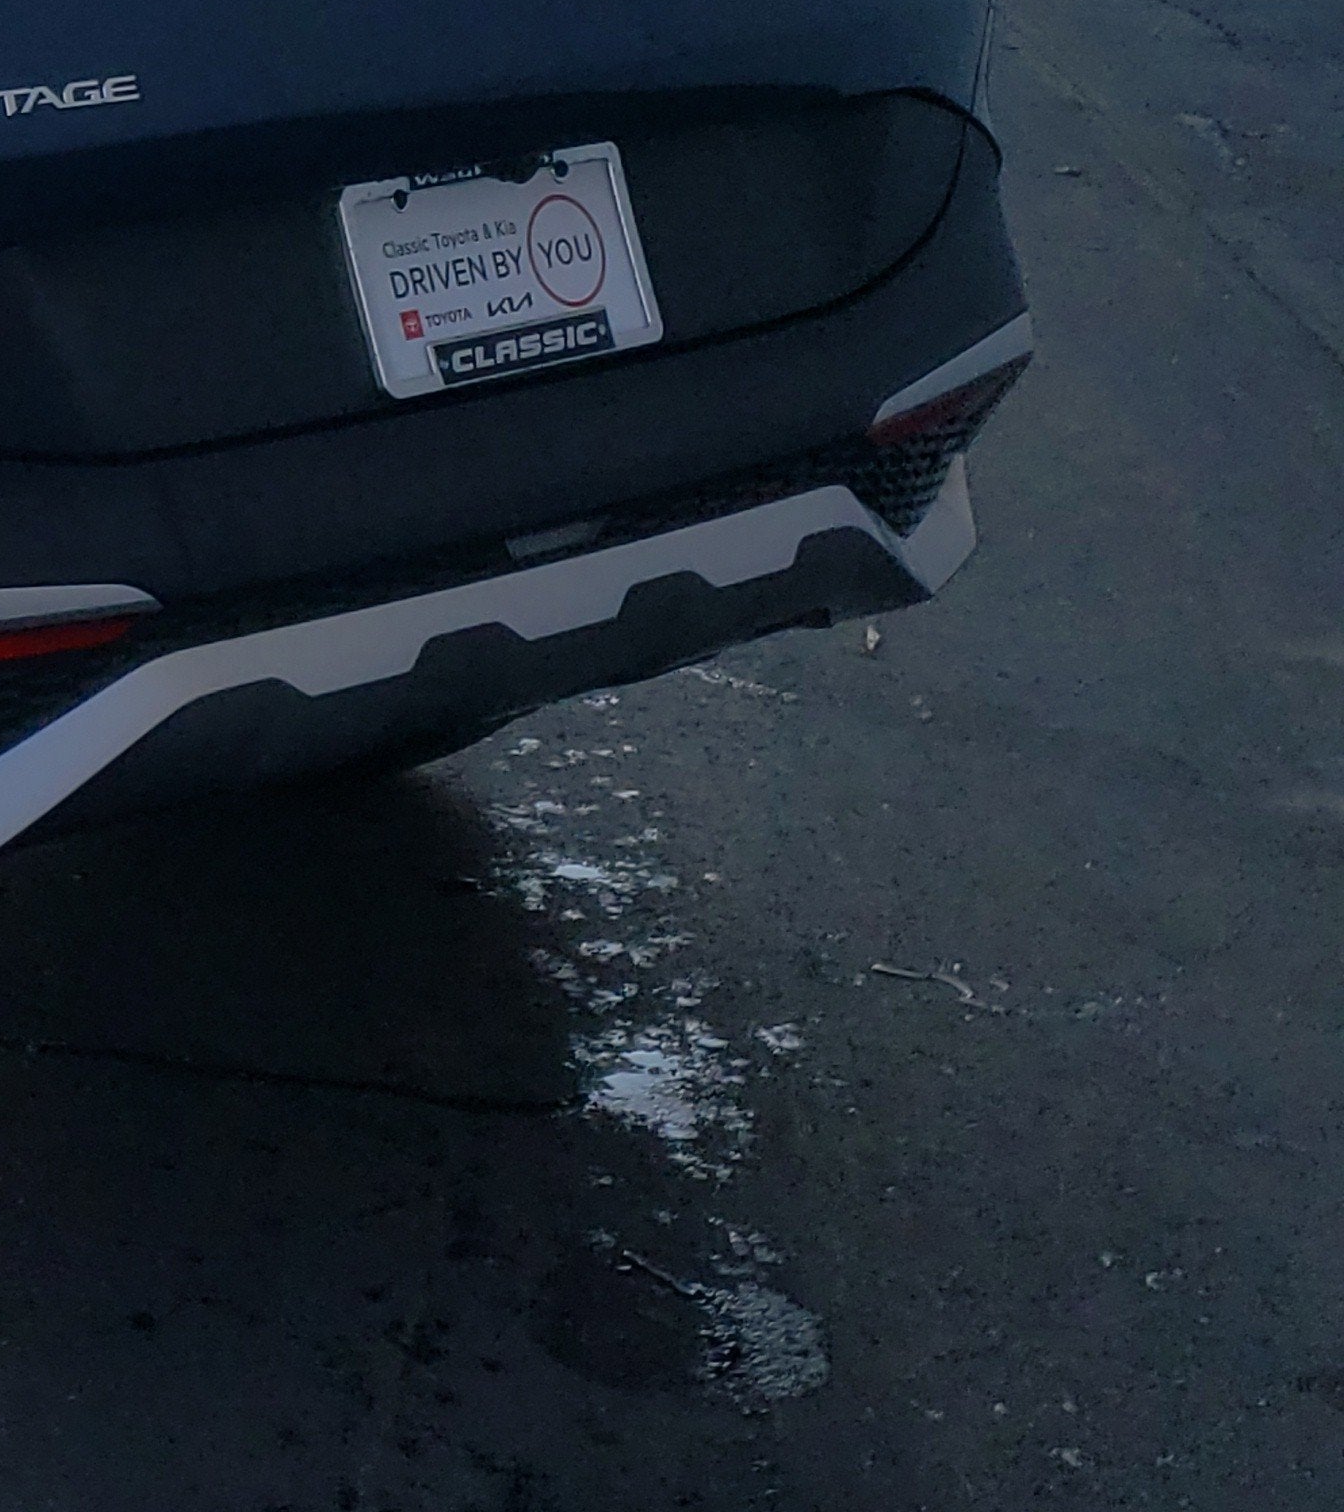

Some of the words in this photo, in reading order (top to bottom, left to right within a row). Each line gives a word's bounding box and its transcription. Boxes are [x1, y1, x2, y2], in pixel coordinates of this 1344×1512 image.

[382, 238, 431, 260] Classic
[431, 228, 480, 252] Toyota
[481, 223, 493, 240] &
[494, 219, 518, 238] Kia
[389, 253, 487, 300] DRIVEN
[492, 246, 523, 279] BY
[537, 233, 593, 269] YOU
[425, 307, 473, 329] TOYOTA
[486, 291, 534, 319] KIA
[451, 321, 600, 374] CLASSIC
